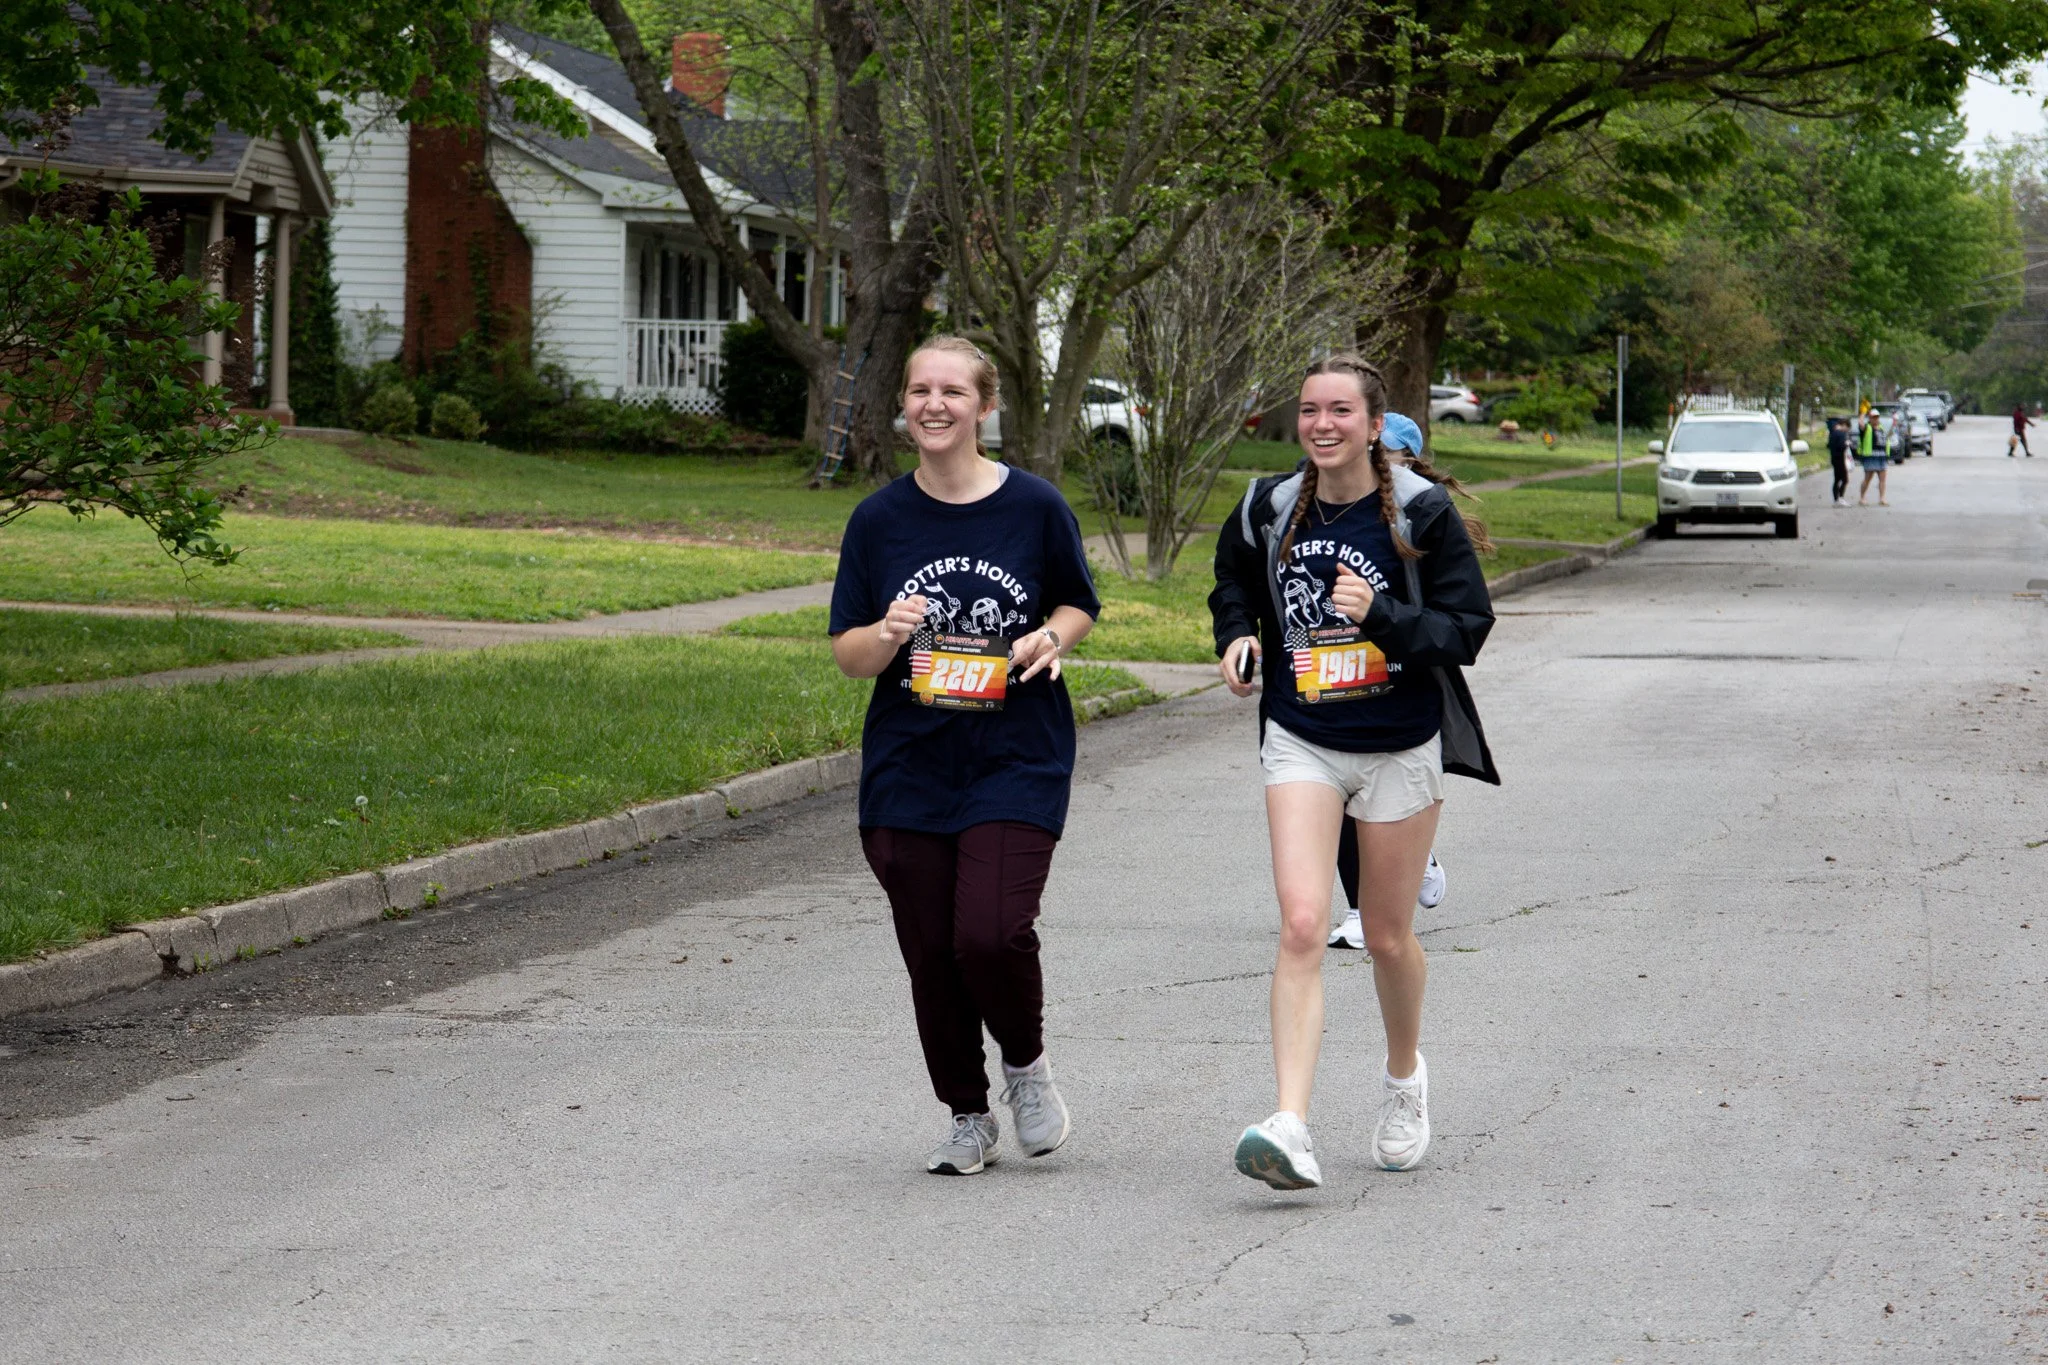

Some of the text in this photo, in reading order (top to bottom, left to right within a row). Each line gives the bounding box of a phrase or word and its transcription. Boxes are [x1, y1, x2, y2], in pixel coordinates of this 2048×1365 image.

[975, 560, 1028, 605] HOUSE
[1338, 544, 1389, 592] HOUSE
[1019, 614, 1028, 624] 26
[929, 658, 996, 693] 2267
[1318, 648, 1367, 685] 1961
[1386, 662, 1402, 672] UN
